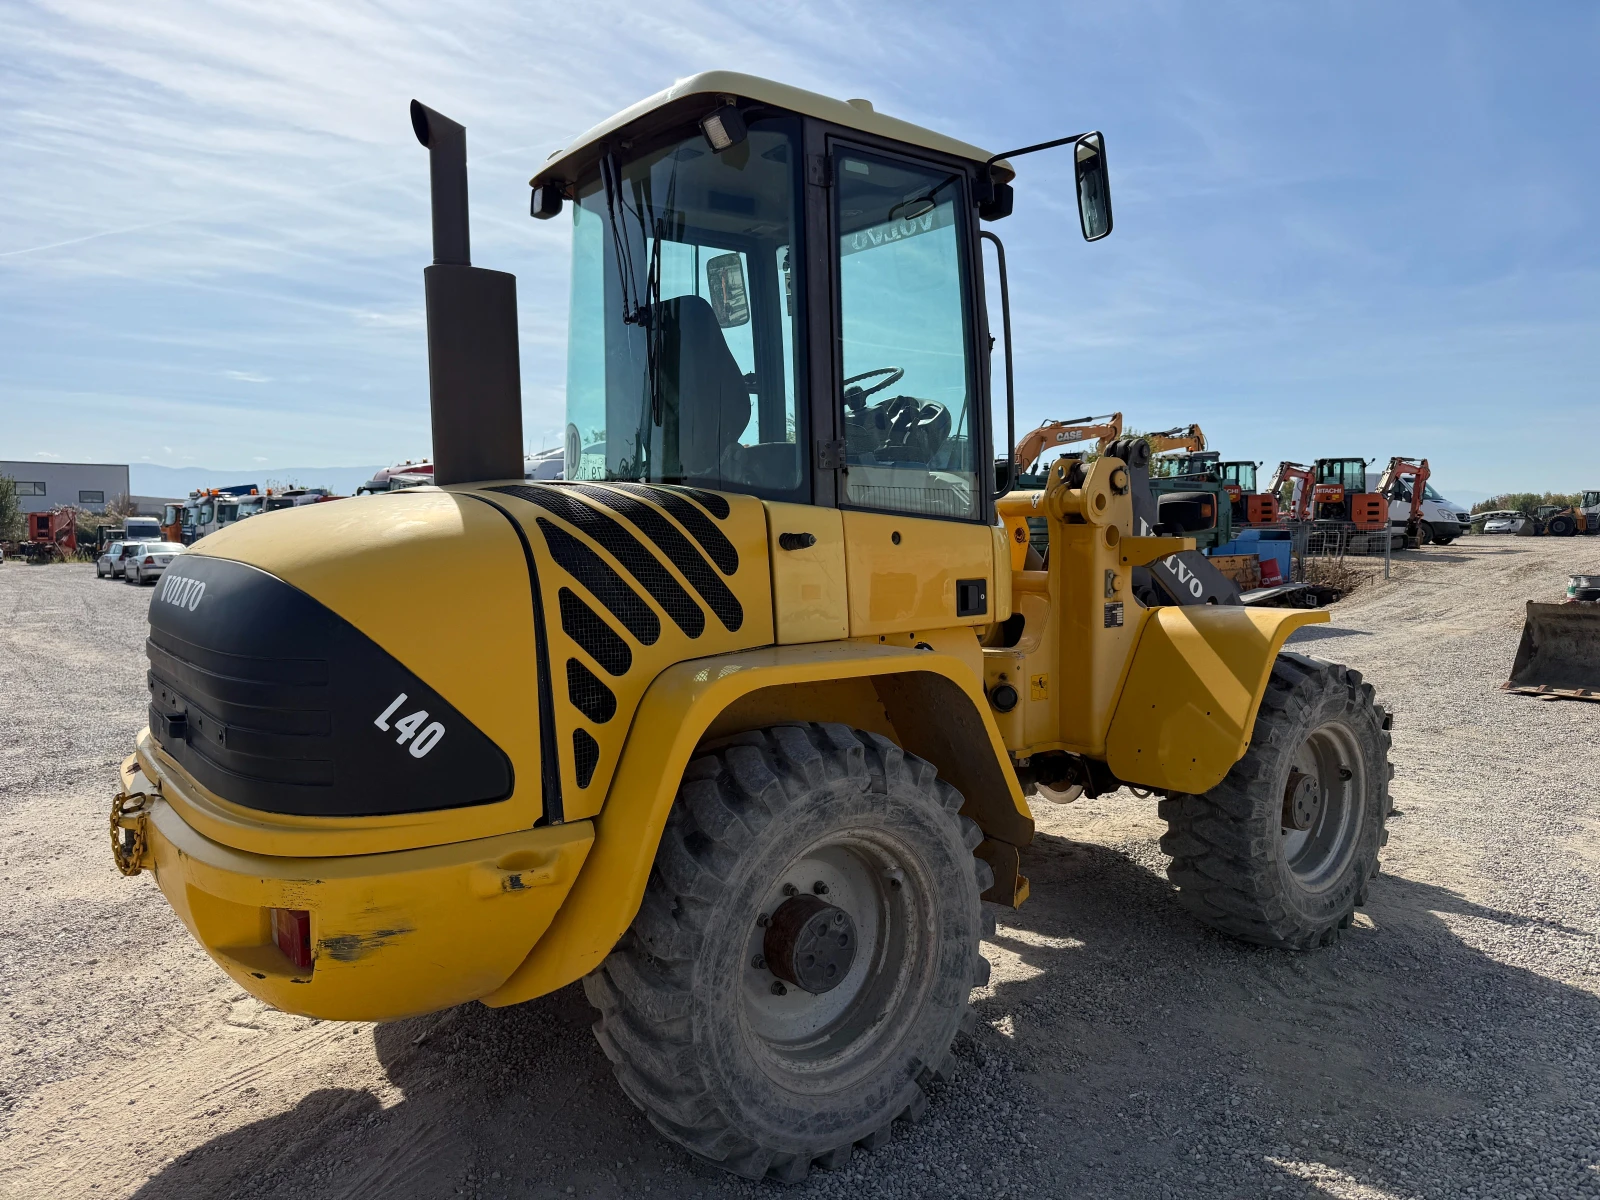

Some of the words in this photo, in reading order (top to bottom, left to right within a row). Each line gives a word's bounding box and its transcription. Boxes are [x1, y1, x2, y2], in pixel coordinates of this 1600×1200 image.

[1056, 430, 1082, 441] CASE
[161, 575, 206, 611] VOLVO
[374, 692, 446, 759] L40
